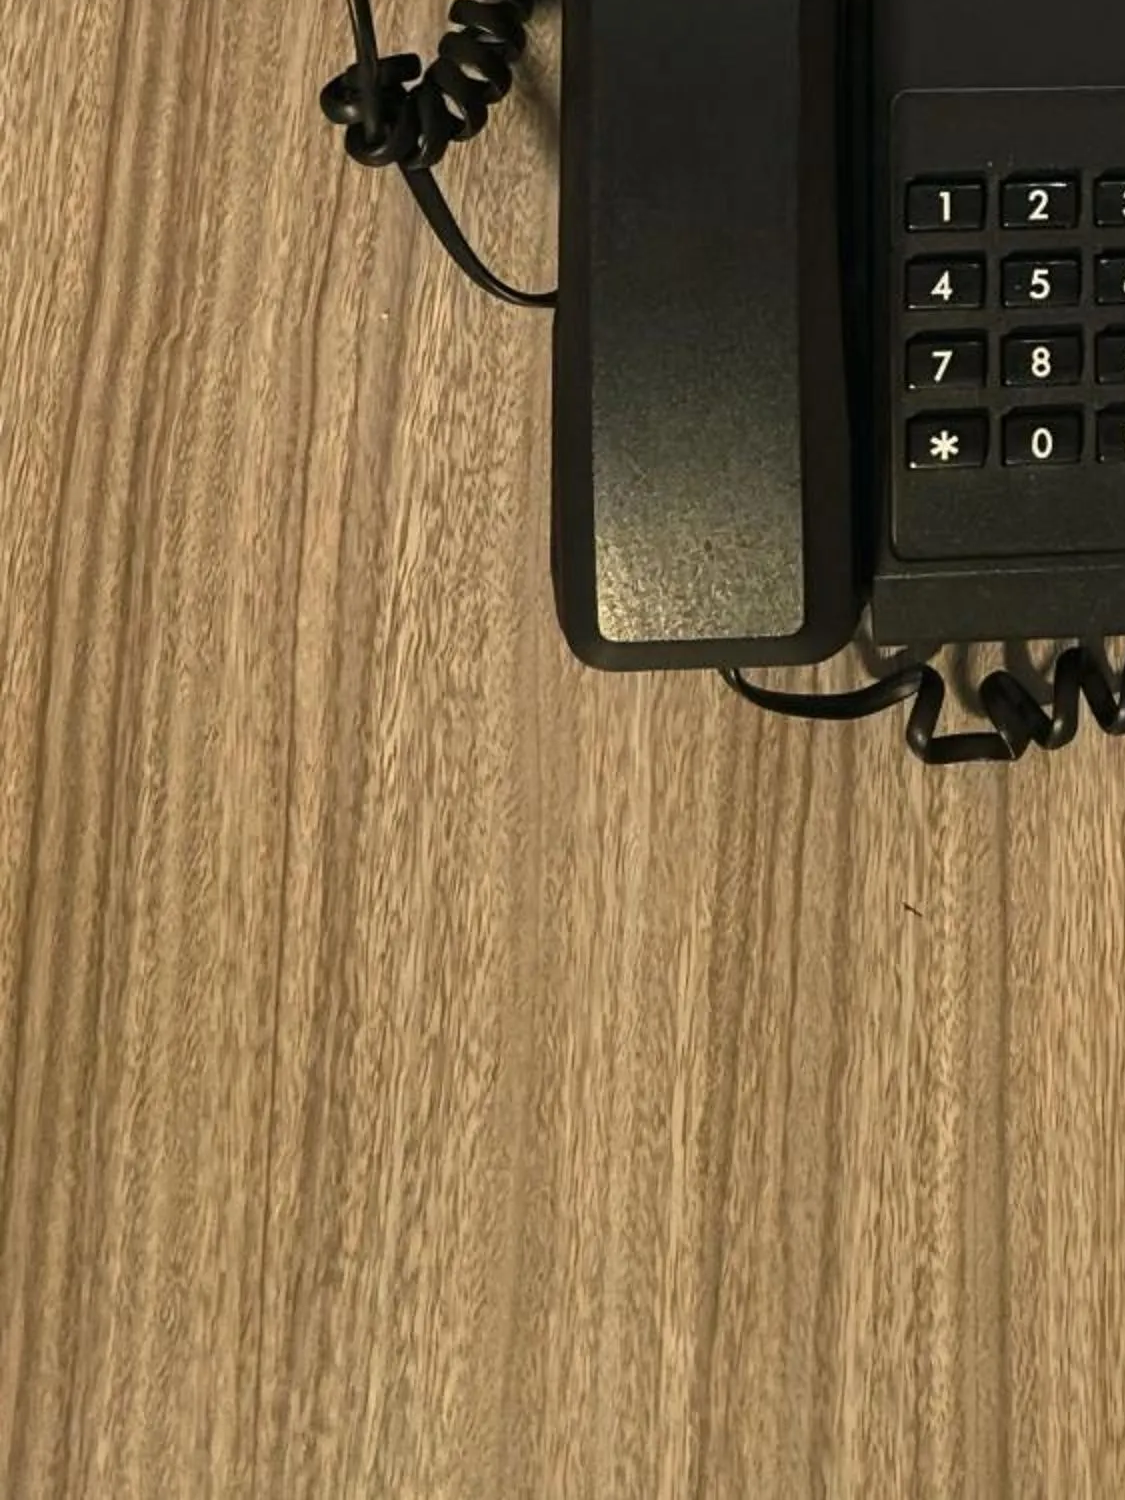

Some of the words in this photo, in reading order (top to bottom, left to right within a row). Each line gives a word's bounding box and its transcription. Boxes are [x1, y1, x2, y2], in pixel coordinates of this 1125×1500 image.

[939, 191, 951, 222] 1
[1028, 189, 1049, 221] 2
[930, 270, 953, 301] 4
[1029, 268, 1051, 300] 5
[932, 350, 953, 382] 7
[1031, 346, 1051, 378] 8
[1031, 427, 1053, 459] 0
